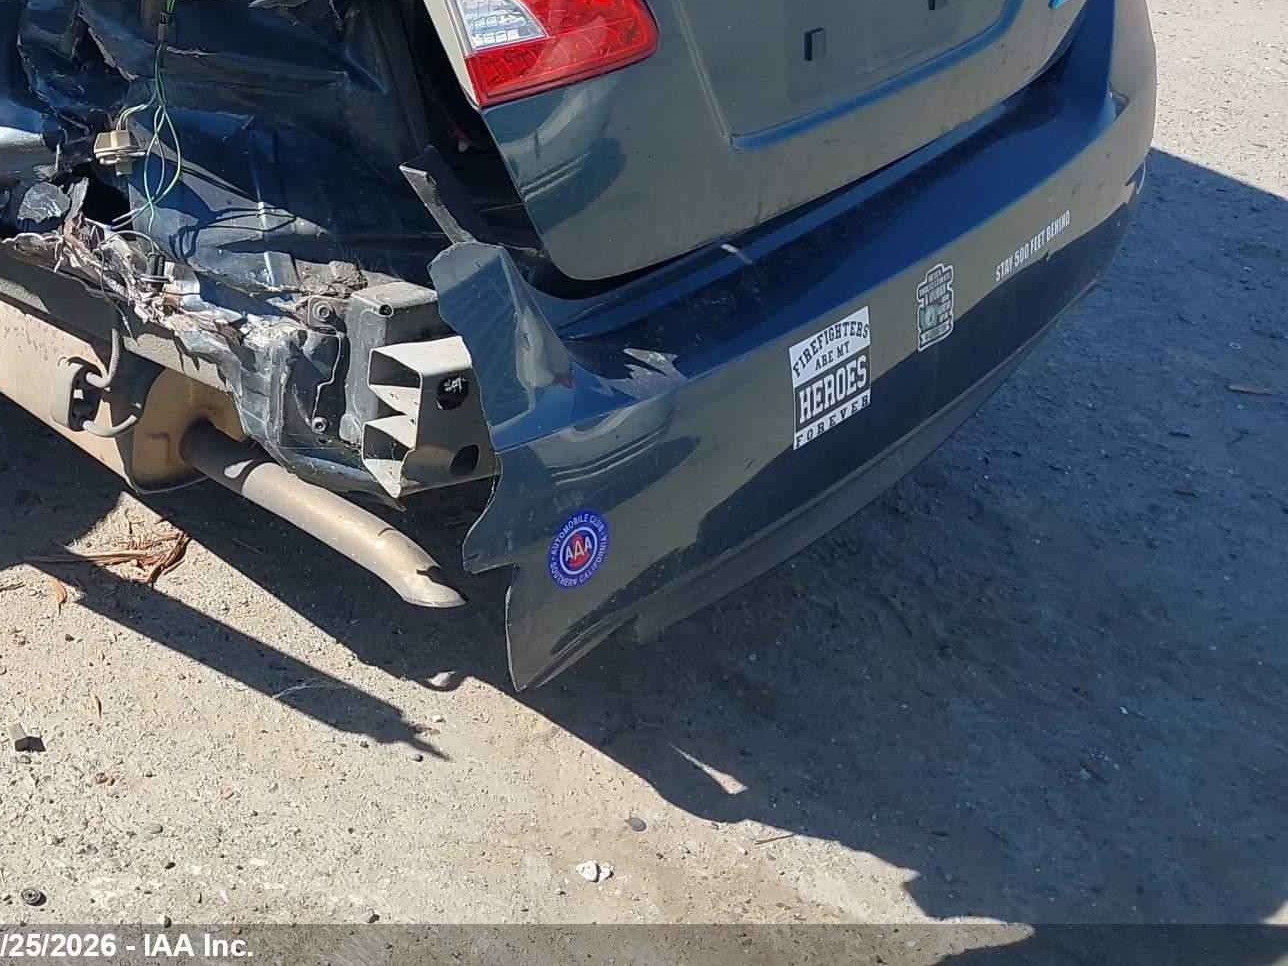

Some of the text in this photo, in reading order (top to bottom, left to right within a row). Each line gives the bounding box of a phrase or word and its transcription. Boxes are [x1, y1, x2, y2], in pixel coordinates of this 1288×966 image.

[995, 209, 1071, 282] STAY 500 FEET BEHIND
[792, 321, 869, 378] FIREFIGHTERS
[815, 340, 850, 371] ARE MY
[799, 355, 867, 424] HEROES
[795, 394, 869, 449] FOREVER
[550, 534, 607, 587] SOUTHERN CALIFORNIA
[551, 514, 605, 555] AUTOMOBILE CLUB
[565, 536, 592, 562] AAA
